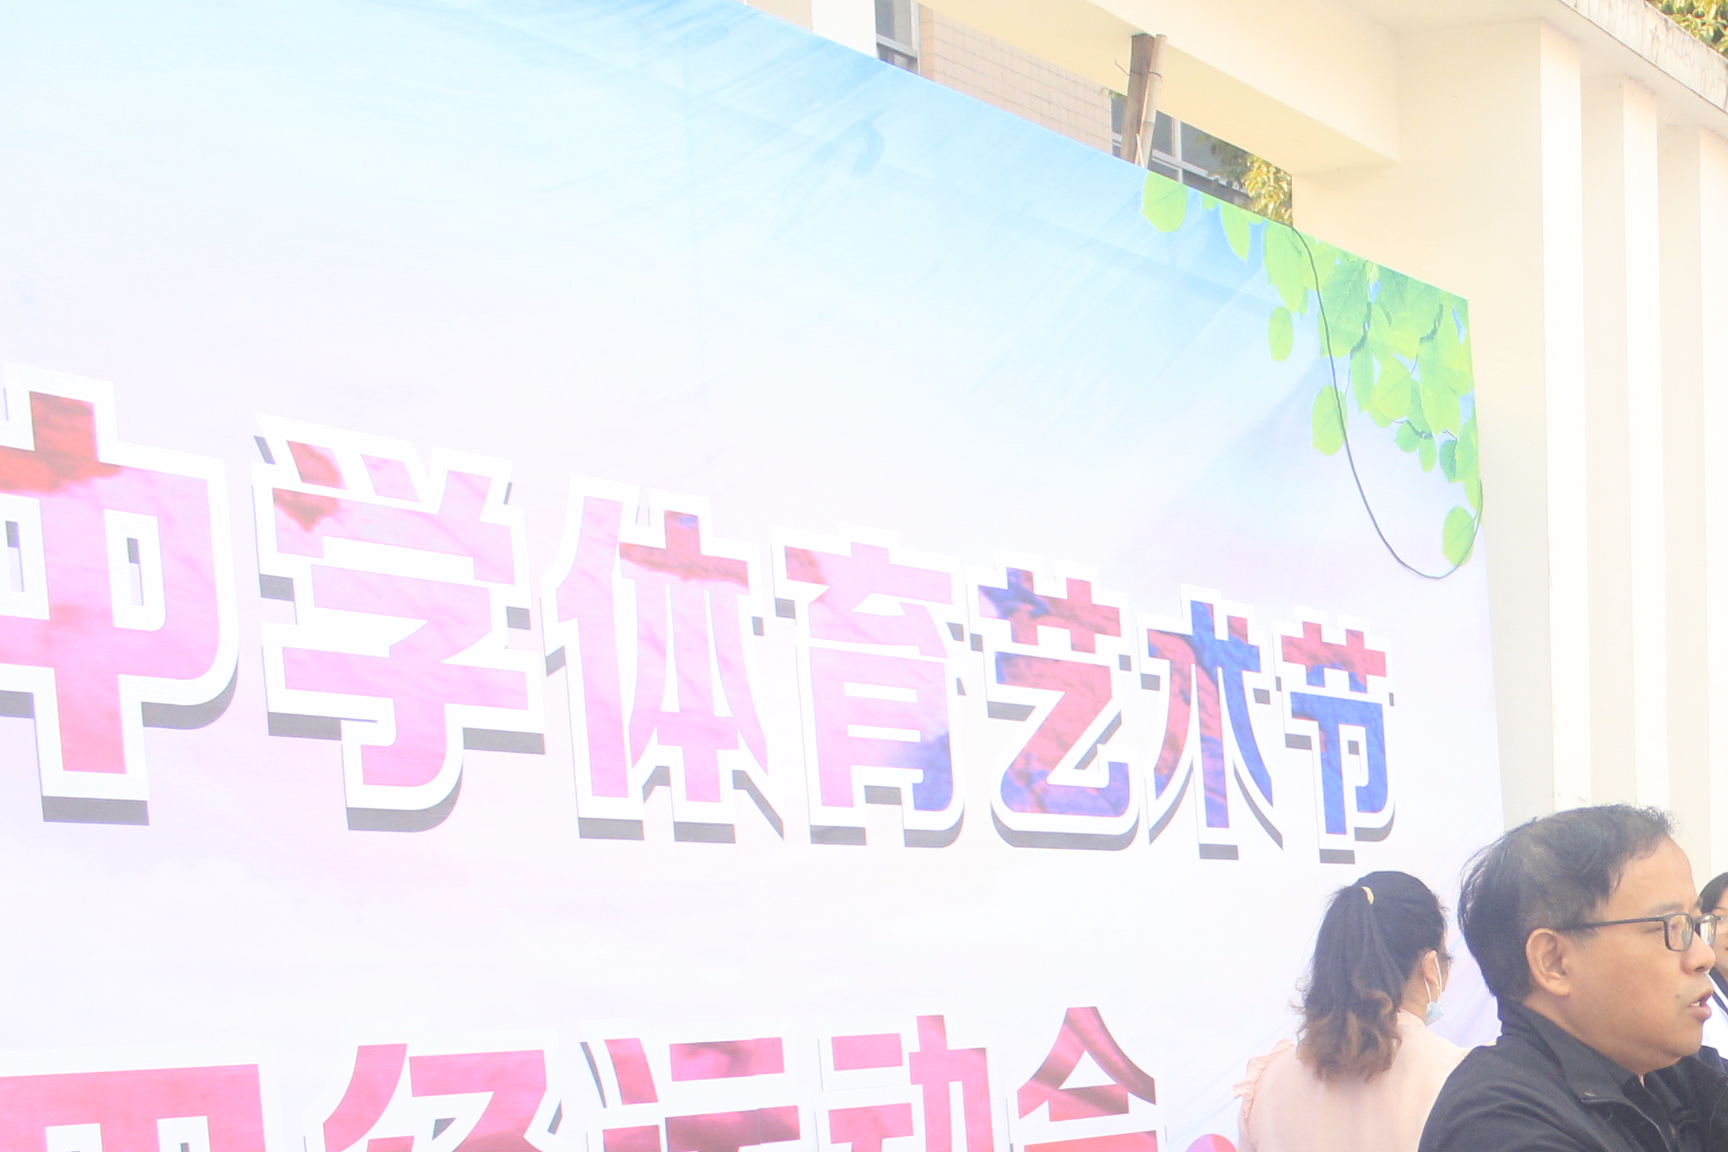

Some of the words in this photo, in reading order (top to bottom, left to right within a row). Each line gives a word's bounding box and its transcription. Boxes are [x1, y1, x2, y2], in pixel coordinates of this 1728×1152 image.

[0, 370, 1397, 862] 中学体育艺术节
